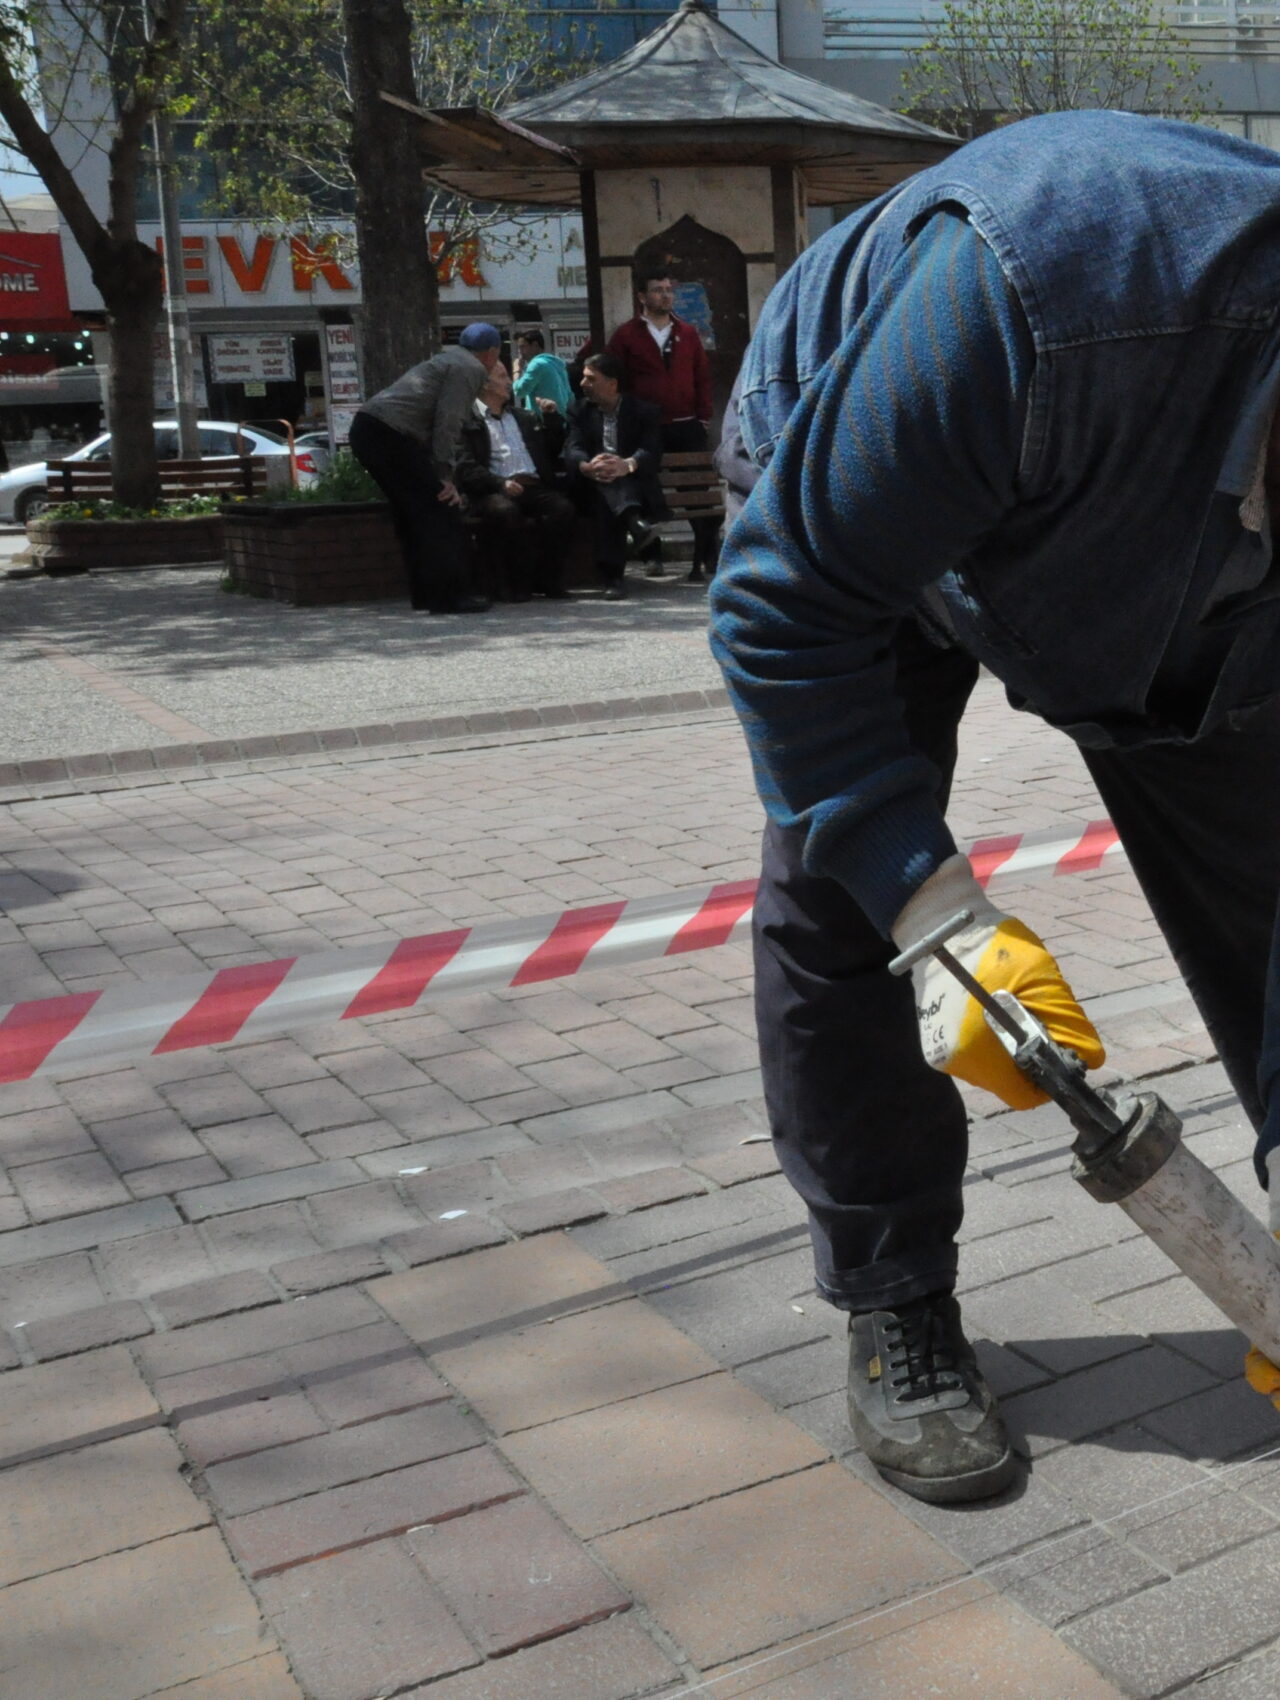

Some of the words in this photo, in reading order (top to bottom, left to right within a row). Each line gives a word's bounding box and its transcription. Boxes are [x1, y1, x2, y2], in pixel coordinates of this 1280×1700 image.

[156, 230, 487, 294] EVKR
[0, 273, 39, 292] ME
[557, 335, 576, 348] EN
